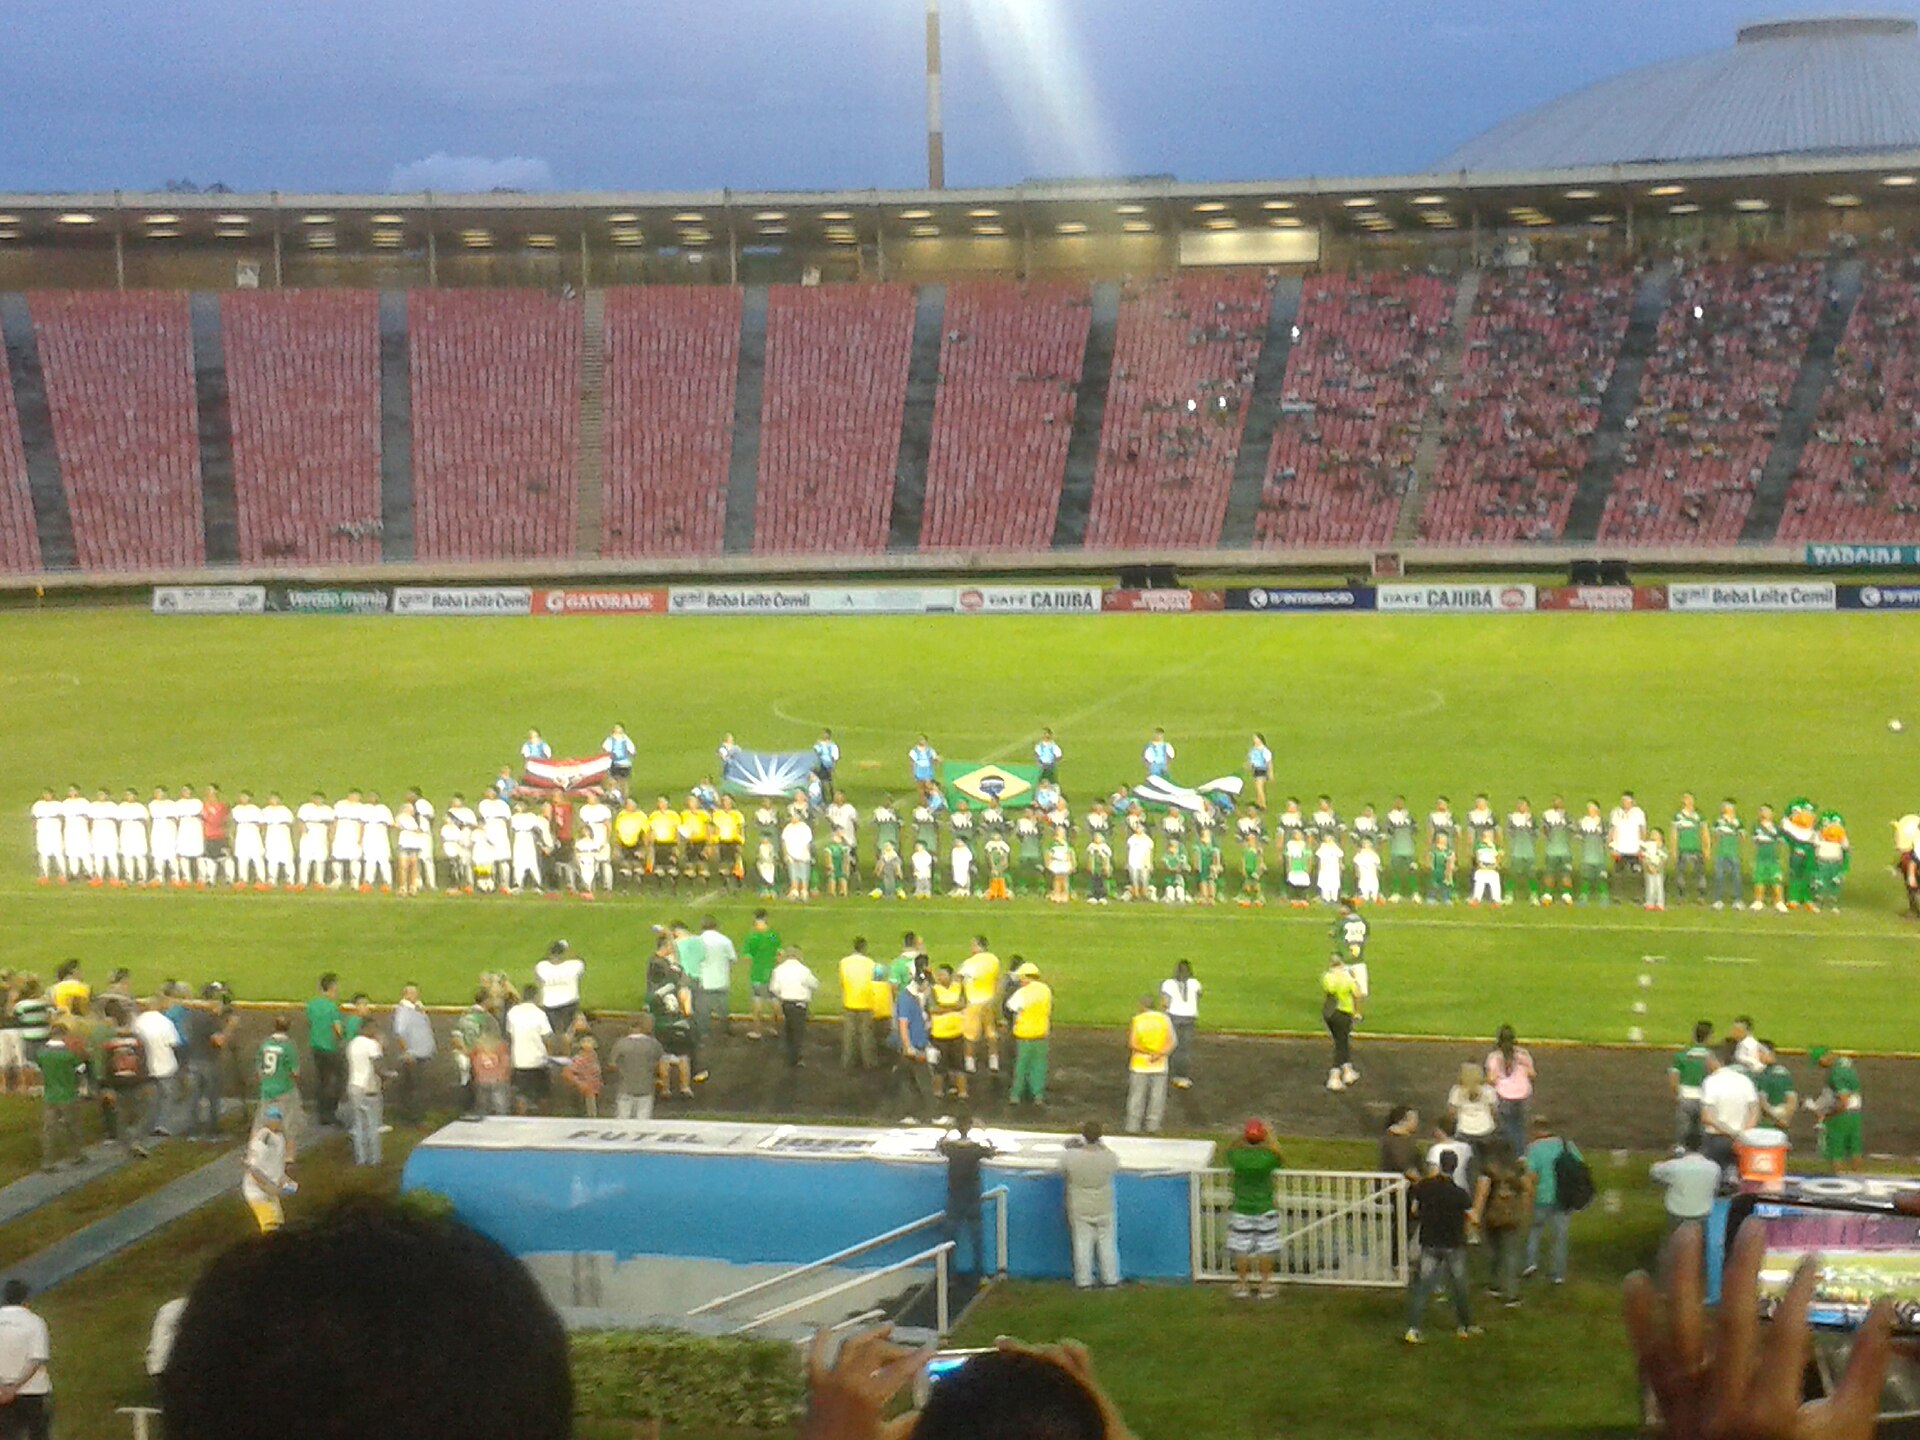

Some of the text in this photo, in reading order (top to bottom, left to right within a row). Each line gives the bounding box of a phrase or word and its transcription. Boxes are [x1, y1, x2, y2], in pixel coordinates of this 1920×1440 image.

[1813, 546, 1901, 565] TORCIDA
[565, 593, 653, 609] GATORADE
[1712, 588, 1749, 604] Beba
[1752, 588, 1789, 604] Leite
[1791, 587, 1833, 604] Cemil
[264, 1052, 277, 1075] 9
[567, 1130, 704, 1144] FUTEL
